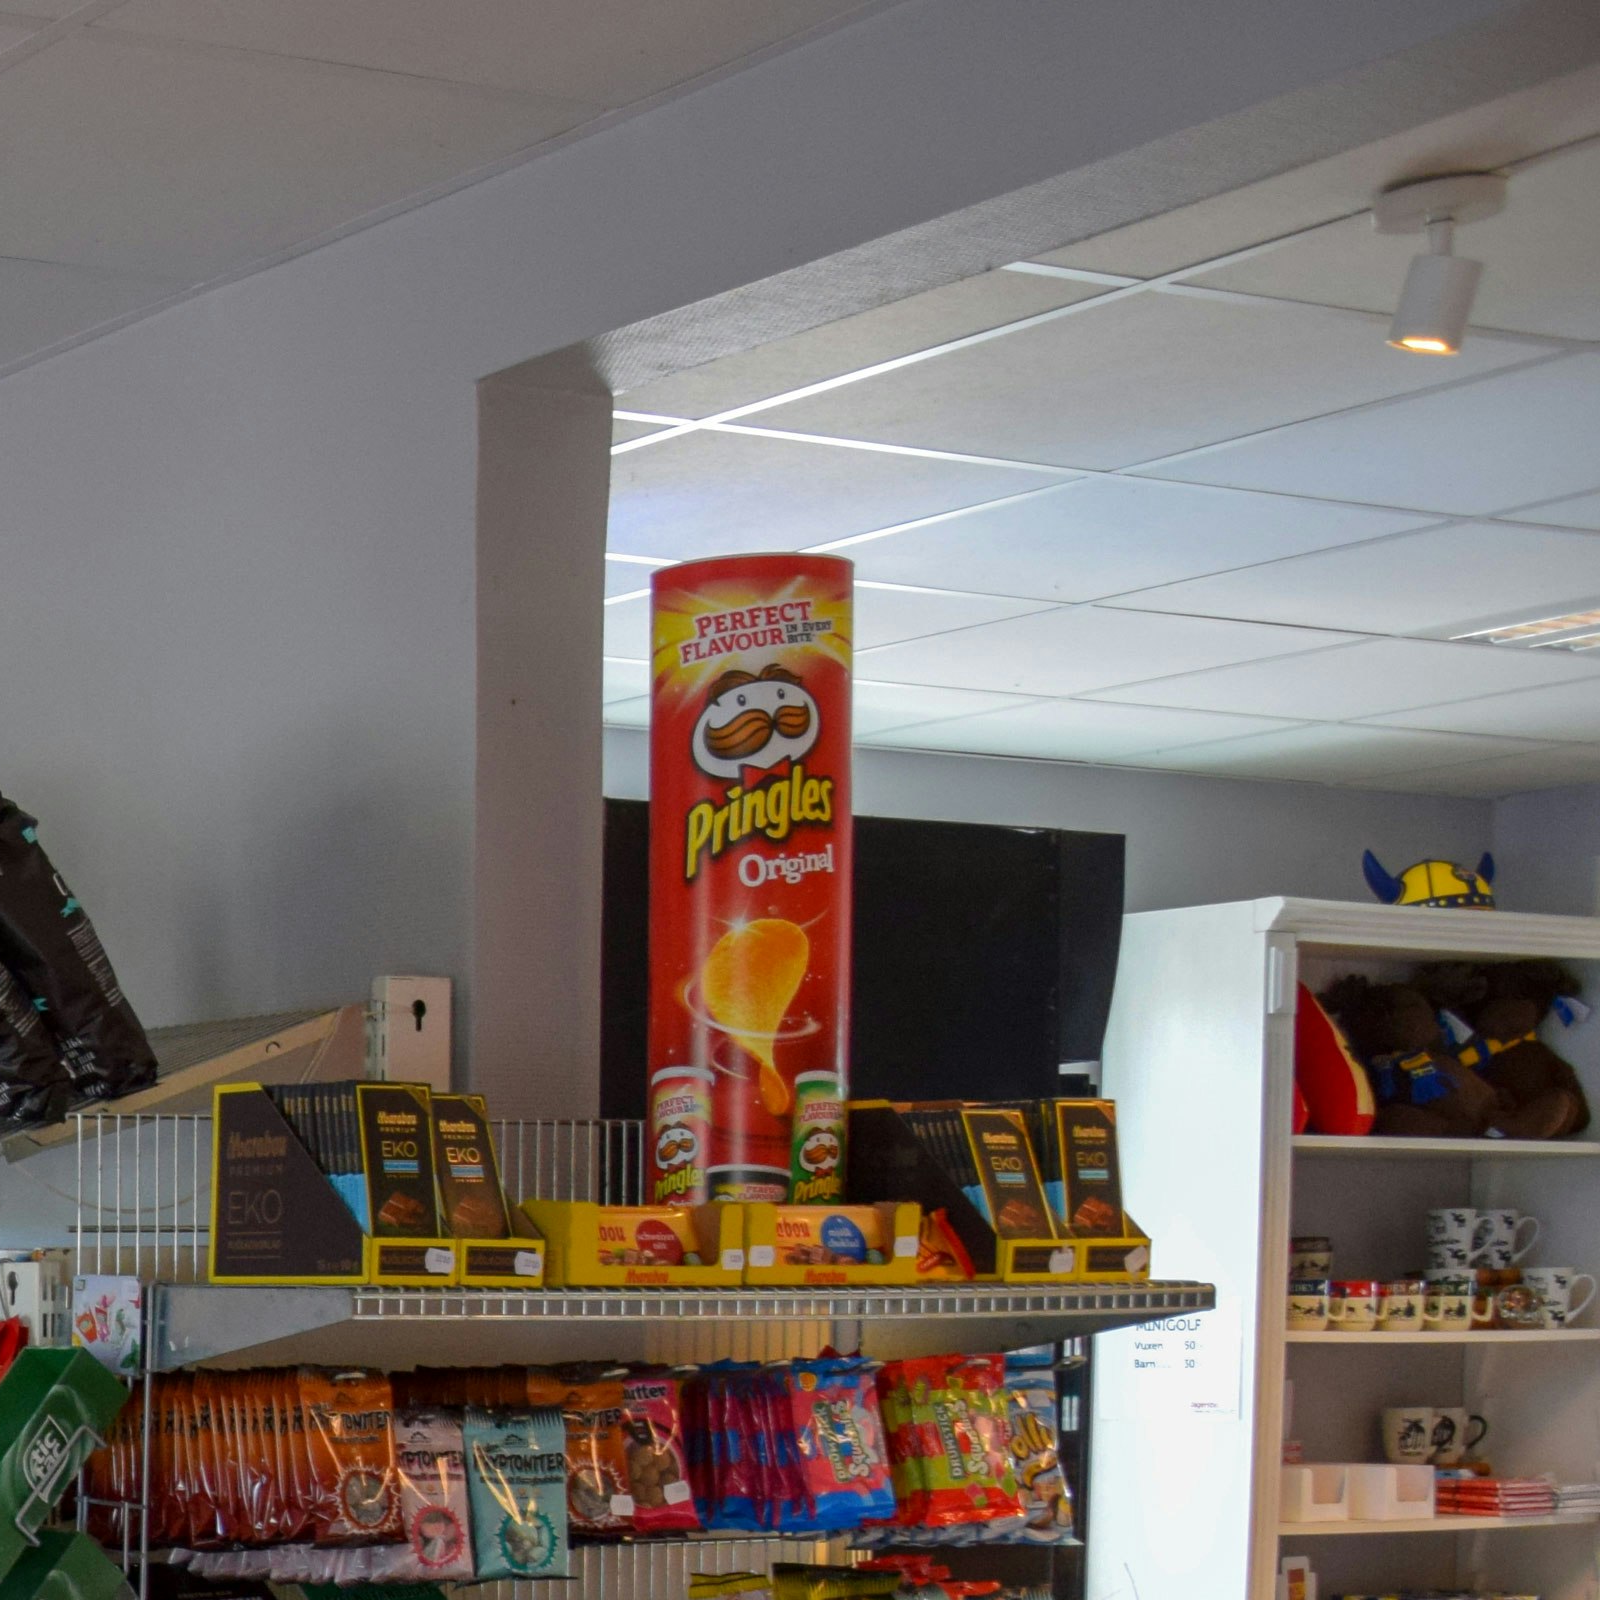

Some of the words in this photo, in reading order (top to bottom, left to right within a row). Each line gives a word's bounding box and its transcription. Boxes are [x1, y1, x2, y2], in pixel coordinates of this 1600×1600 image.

[695, 601, 811, 639] PERFECT
[785, 622, 798, 634] IN
[800, 620, 832, 633] EVERY
[681, 628, 784, 664] FLAVOUR
[787, 632, 813, 644] BITE
[686, 766, 833, 879] Pringles
[738, 844, 833, 887] Original
[382, 1141, 417, 1158] EKO
[447, 1147, 481, 1163] EKO
[992, 1157, 1022, 1171] EKO
[1076, 1152, 1107, 1166] EKO
[228, 1189, 284, 1225] EKO
[1136, 1319, 1201, 1332] MINIGOLF
[1135, 1341, 1163, 1351] Vuxen
[1134, 1360, 1156, 1369] Barn
[31, 1430, 58, 1464] tic
